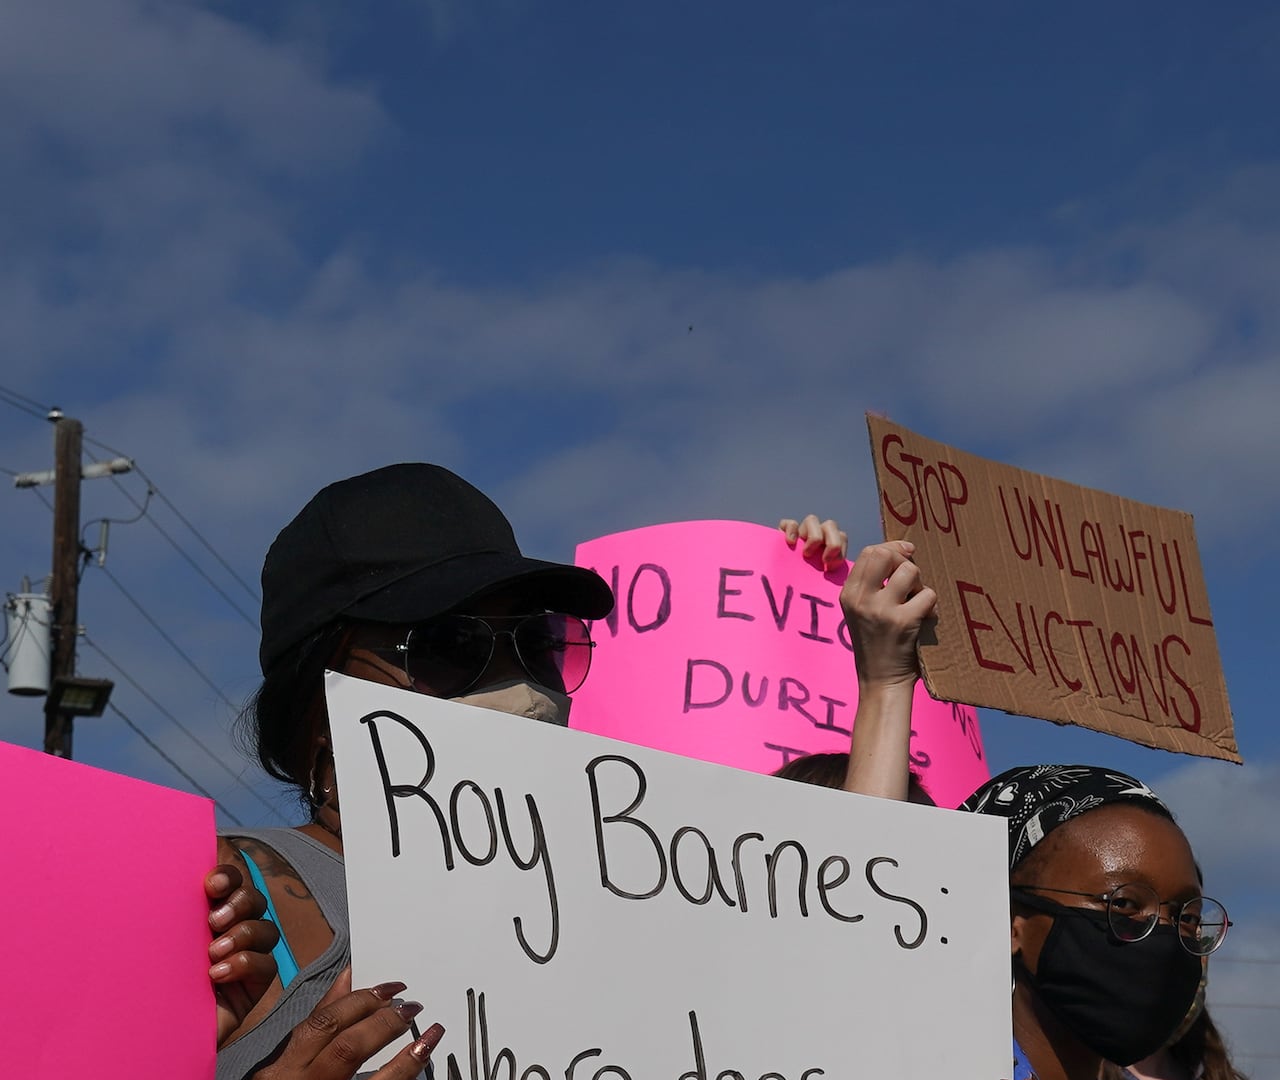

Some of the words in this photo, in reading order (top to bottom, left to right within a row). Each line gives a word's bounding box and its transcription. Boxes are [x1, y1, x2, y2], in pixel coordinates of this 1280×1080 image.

[881, 433, 969, 548] STOP
[998, 485, 1214, 628] UNLAWFUL
[956, 580, 1201, 734] EVICTIONS
[359, 709, 560, 965] Roy
[585, 754, 949, 950] Barnes:
